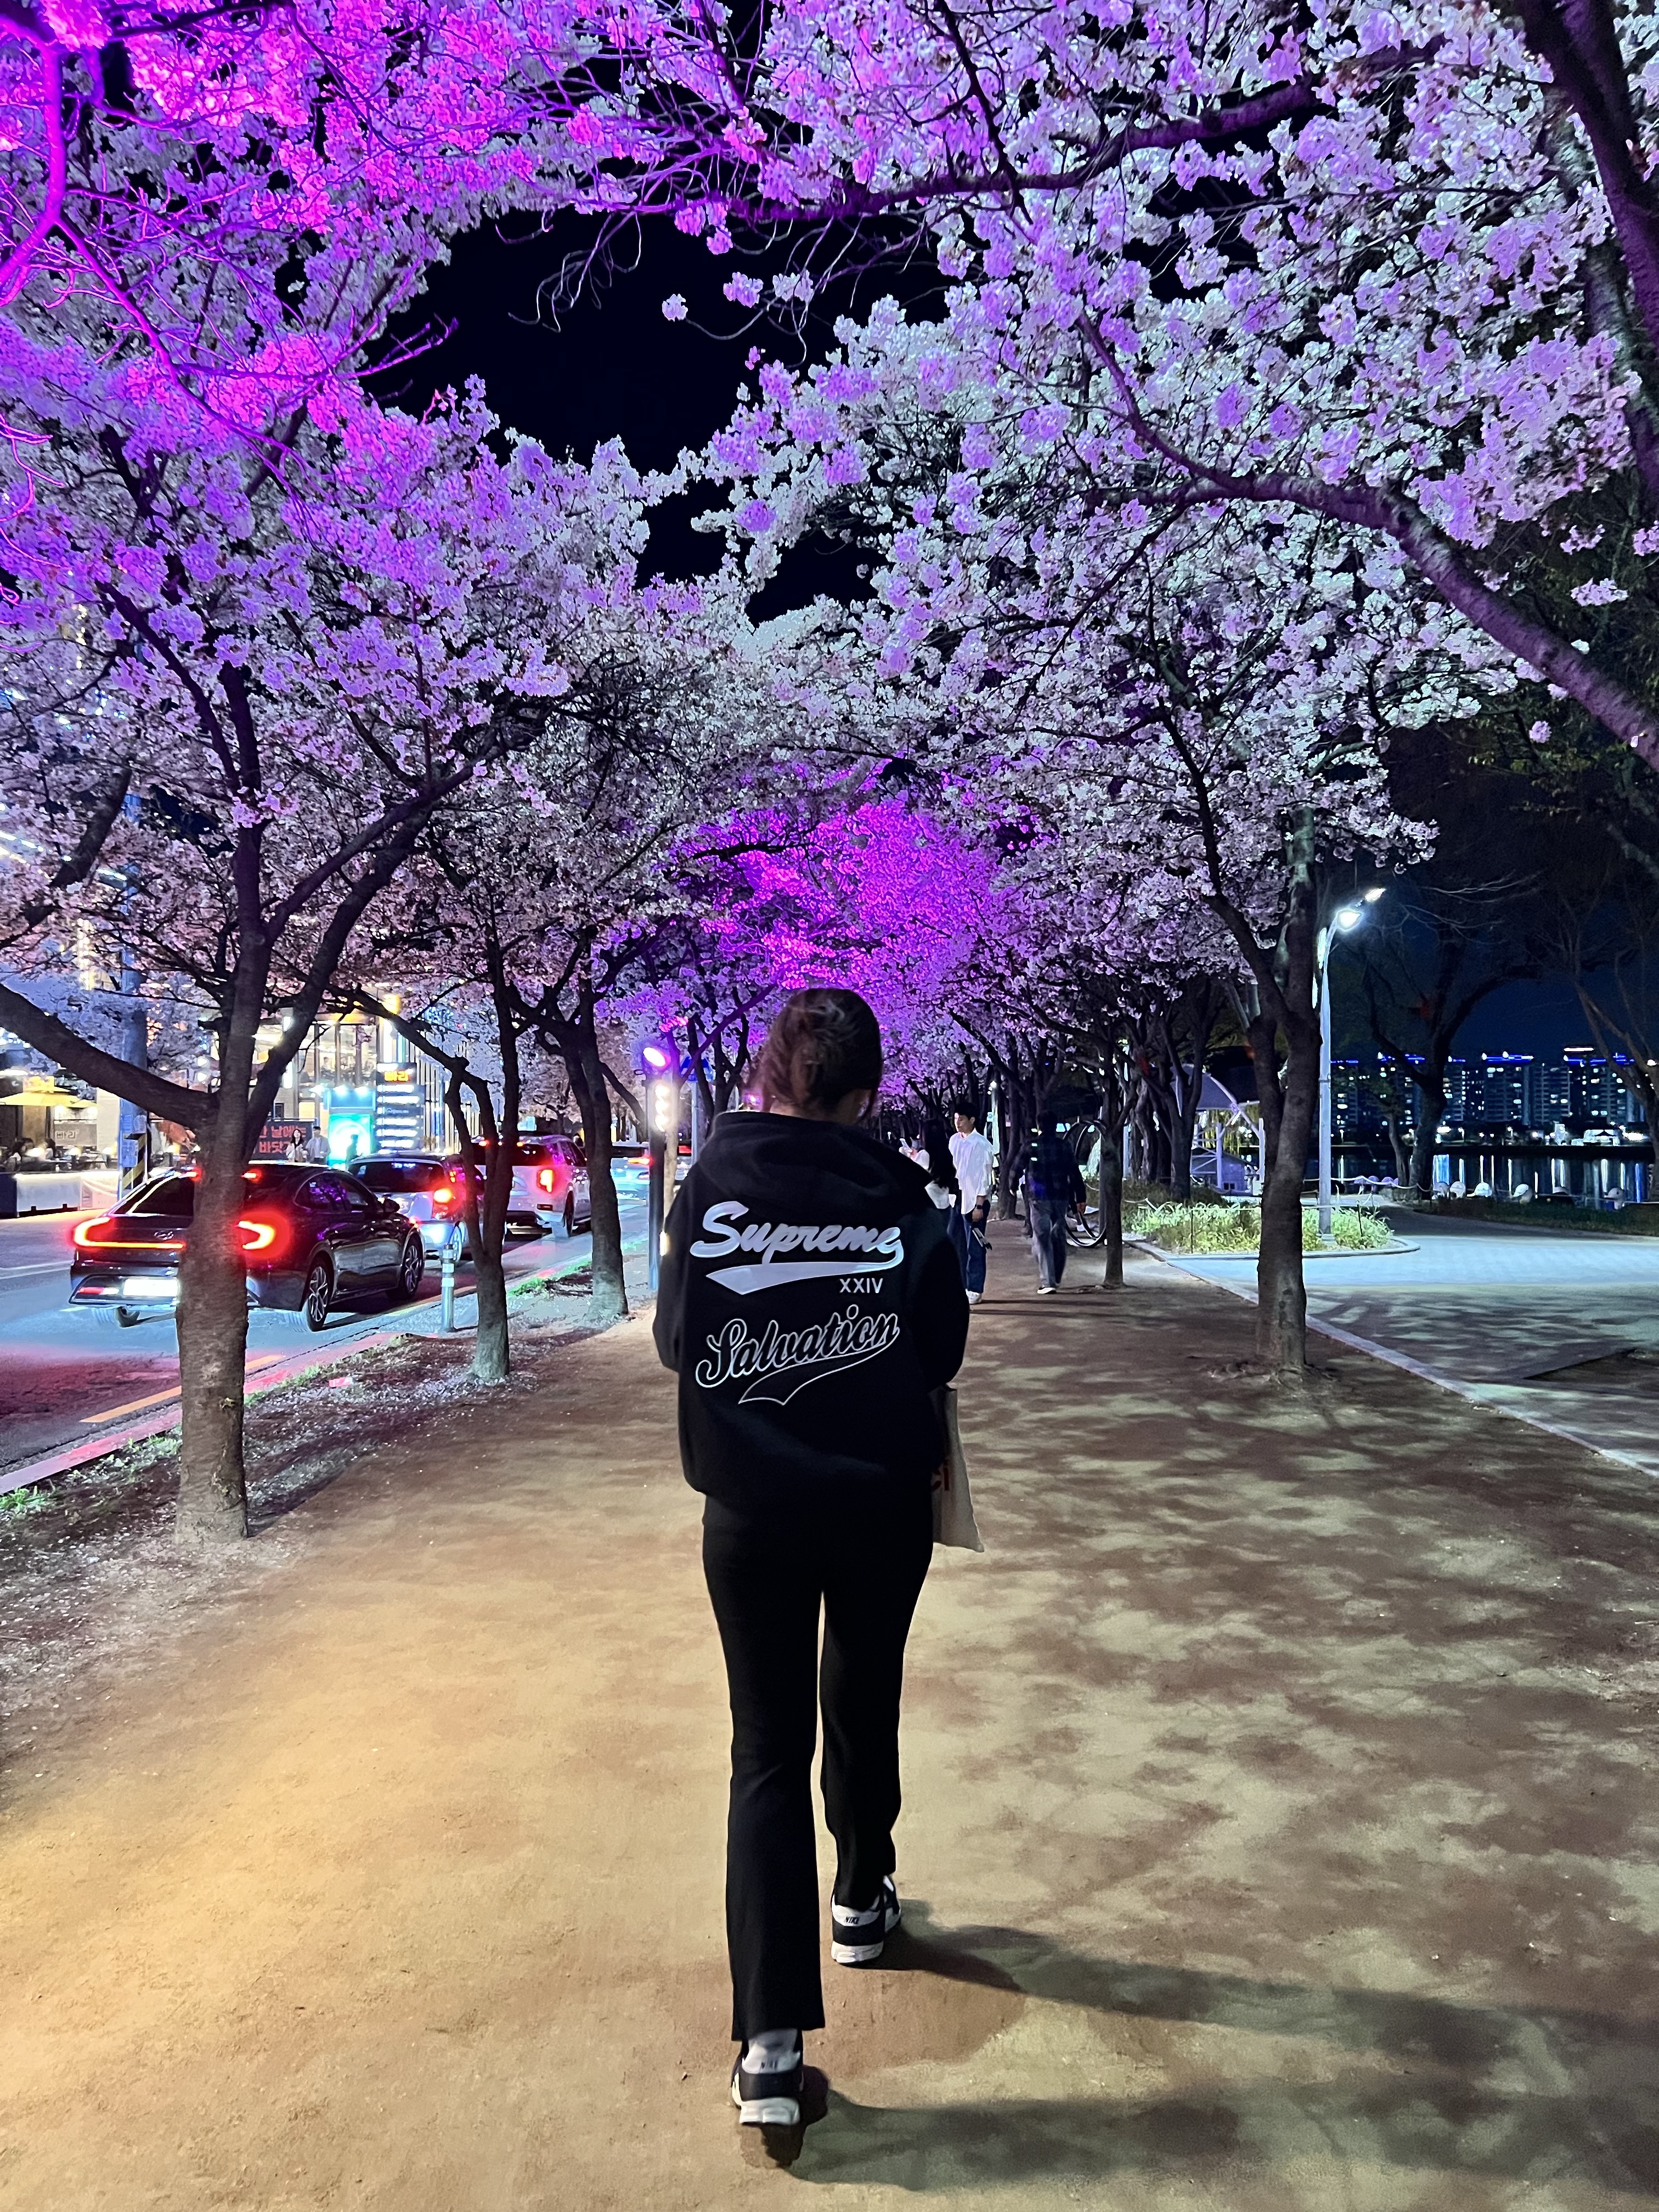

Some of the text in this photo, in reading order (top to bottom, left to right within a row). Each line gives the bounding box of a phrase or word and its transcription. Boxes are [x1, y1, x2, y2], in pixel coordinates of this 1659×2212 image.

[690, 1200, 904, 1268] Supreme
[839, 1277, 883, 1294] XXIV
[695, 1304, 900, 1389] Salvation
[845, 1916, 860, 1925] NIKE
